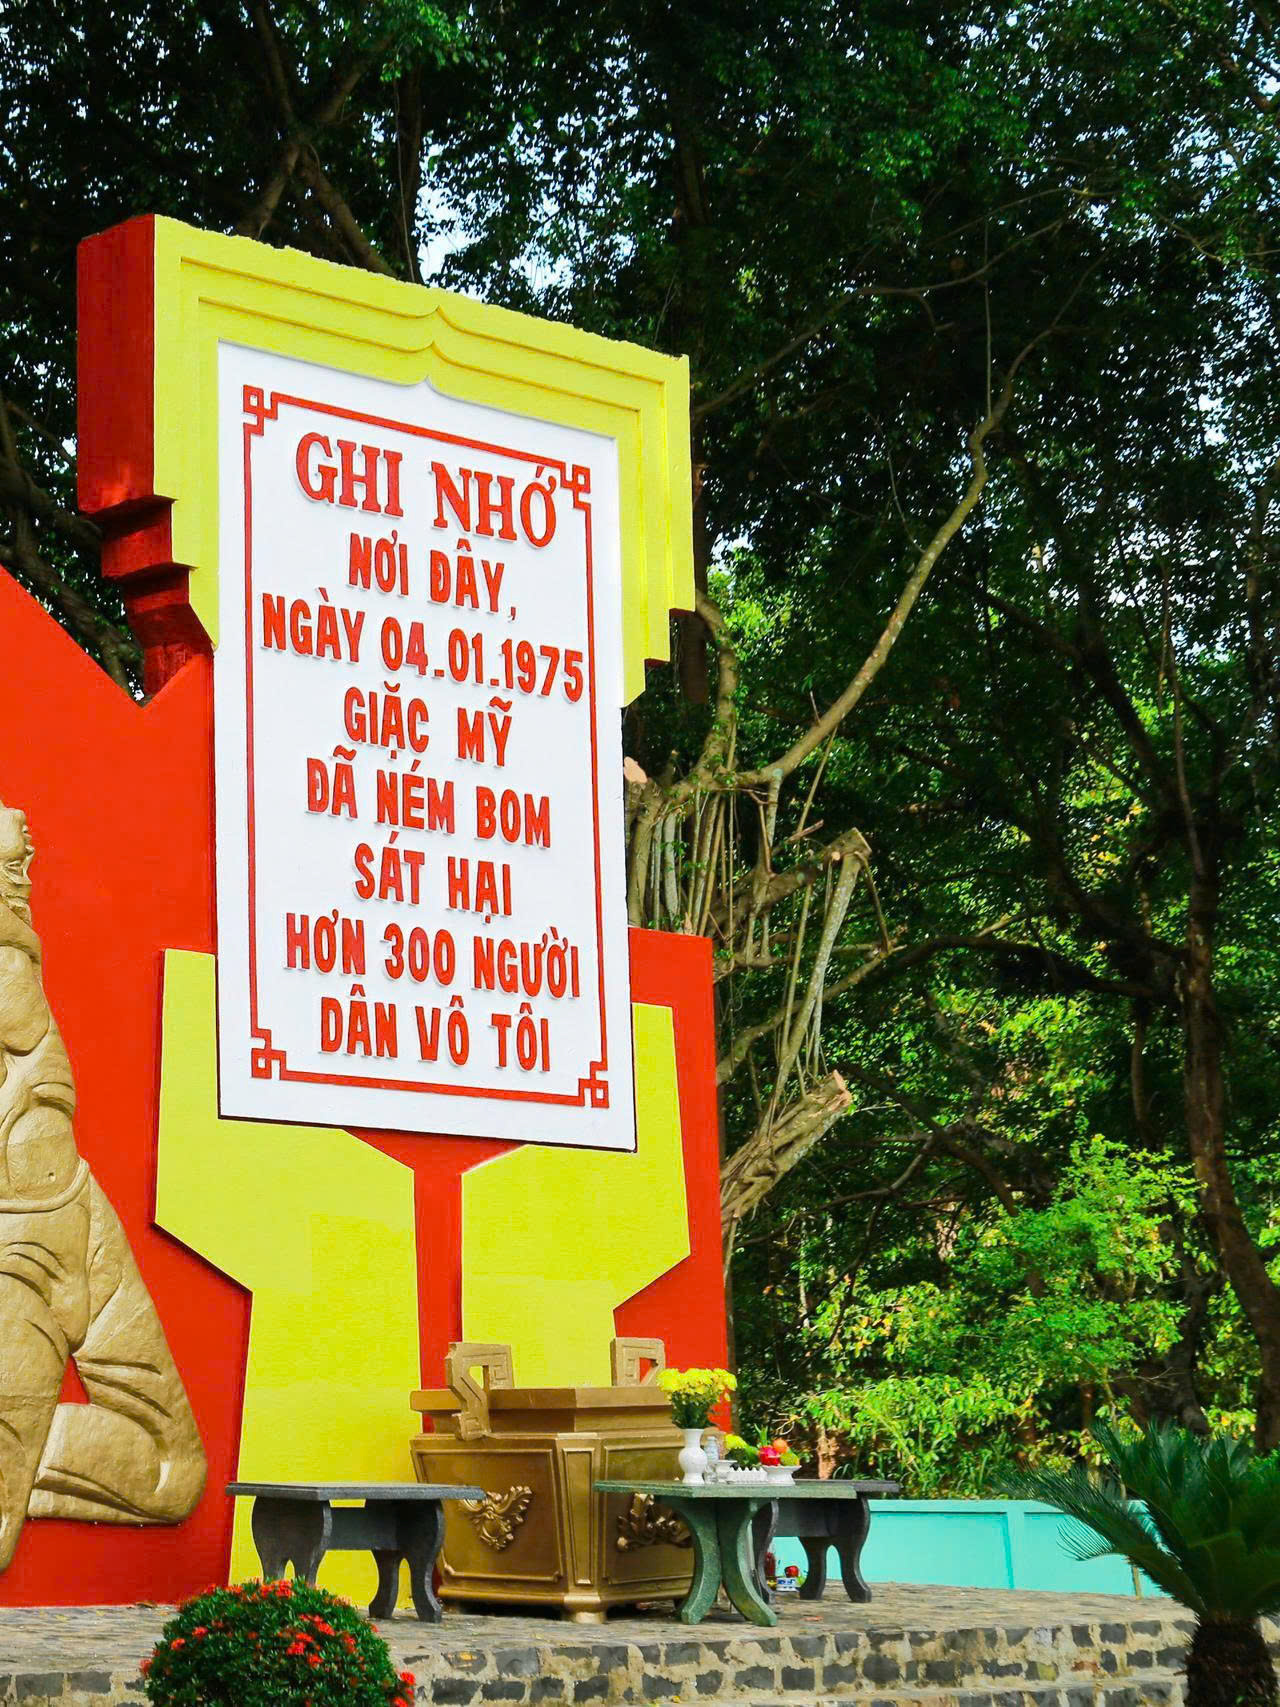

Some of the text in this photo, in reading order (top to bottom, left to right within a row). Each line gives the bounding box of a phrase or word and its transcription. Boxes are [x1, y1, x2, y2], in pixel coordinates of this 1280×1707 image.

[295, 431, 558, 549] GHI NHỚ
[349, 529, 517, 622] NƠI ĐÂY,
[262, 587, 585, 704] NGÀY 04.01.1975
[343, 681, 513, 768] GIẶC MỸ
[306, 744, 552, 849] ĐÃ NÉM BOM
[354, 831, 513, 924] SÁT HẠI
[286, 908, 581, 999] HƠN 300 NGƯỜI
[320, 984, 551, 1073] DÂN VÔ TÔI
